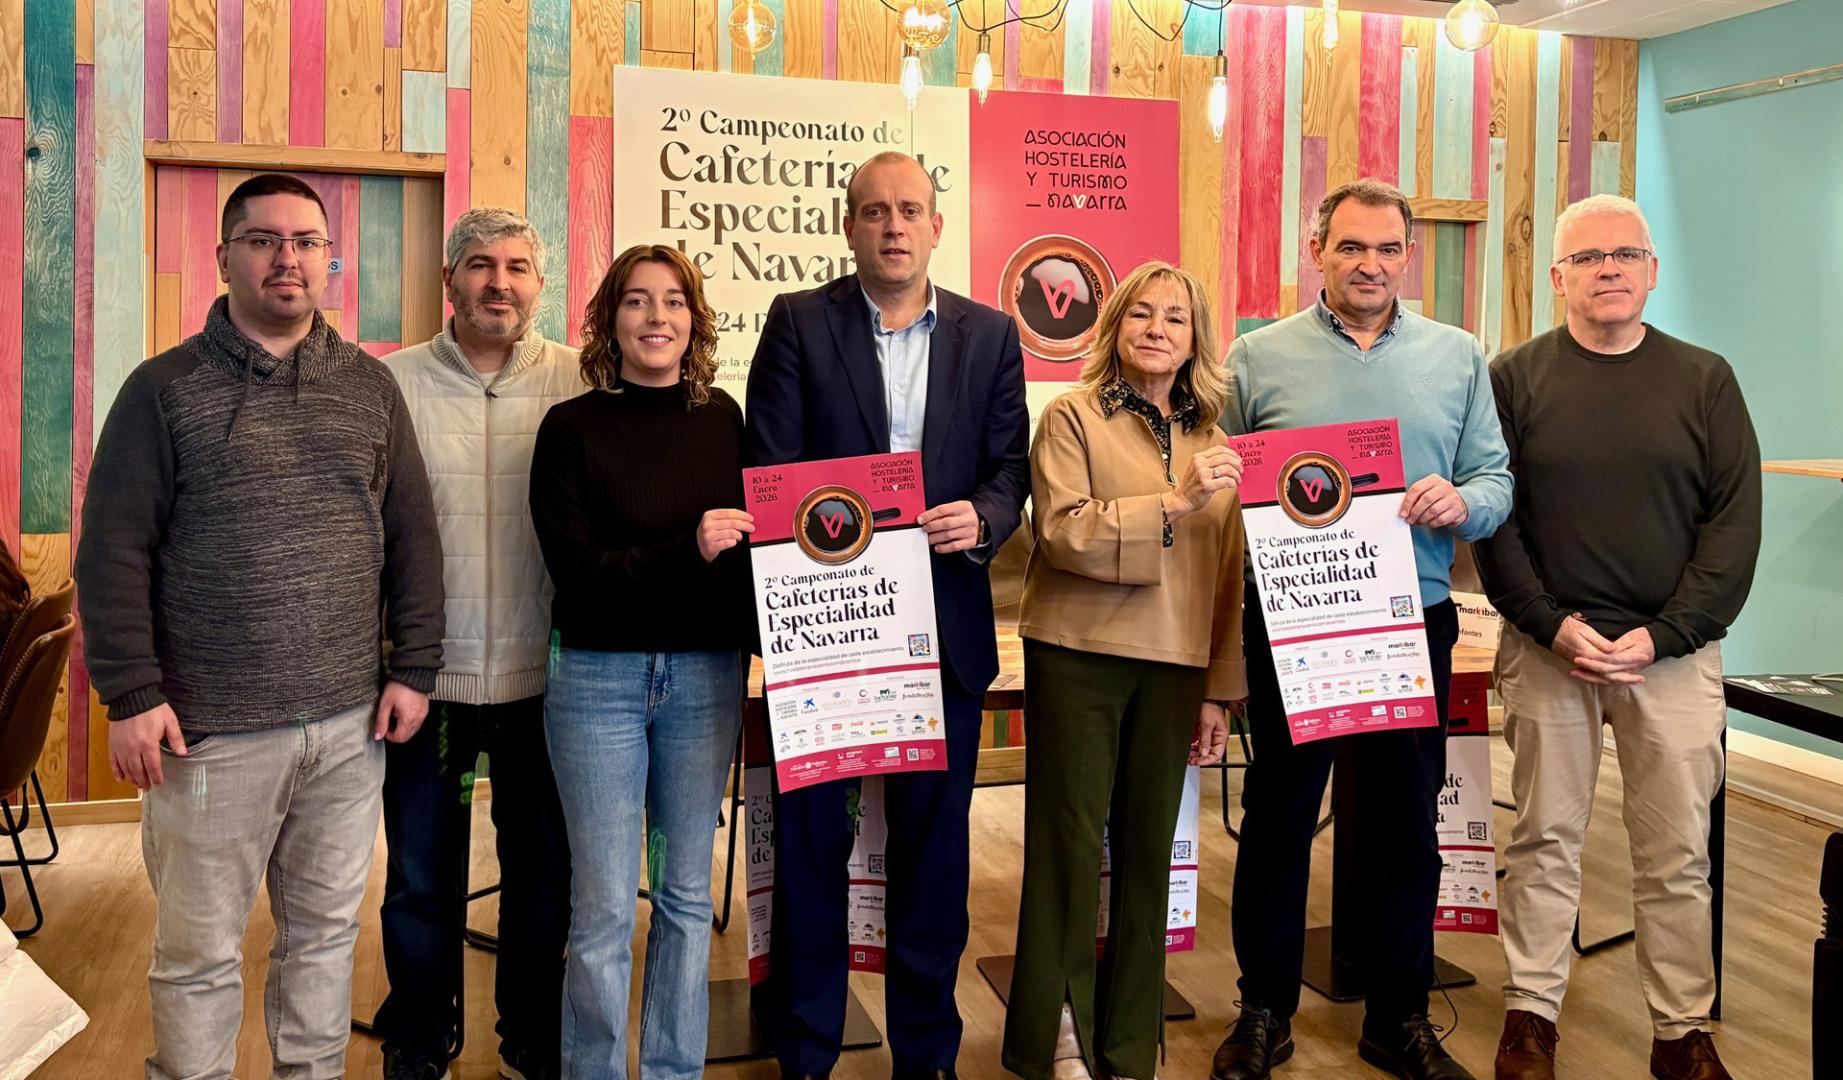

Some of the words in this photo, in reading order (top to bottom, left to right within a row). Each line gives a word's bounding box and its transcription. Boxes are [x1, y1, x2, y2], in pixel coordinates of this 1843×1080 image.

[700, 109, 865, 145] Campeonato
[872, 120, 904, 145] de
[1024, 129, 1126, 149] ASOCIACIÓN
[660, 140, 858, 190] Cafetería
[1024, 150, 1127, 170] HOSTELERÍA
[1026, 171, 1038, 187] Y
[1048, 171, 1128, 190] TURISMO
[660, 189, 851, 245] Especial
[731, 241, 857, 283] Navar
[717, 311, 746, 333] 24
[1347, 425, 1391, 437] ASOCIACIÓN
[870, 458, 914, 470] ASOCIACIÓN
[755, 494, 778, 504] 2026
[1269, 530, 1338, 549] Campeonato
[1340, 528, 1355, 540] de
[1258, 545, 1350, 570] Cafeterías
[1355, 541, 1380, 560] de
[781, 568, 857, 587] Campeonato
[860, 564, 875, 577] de
[1261, 560, 1378, 595] Especialidad
[765, 582, 869, 611] Cafeterías
[874, 577, 900, 597] de
[1266, 594, 1289, 614] de
[1289, 587, 1363, 611] Navarra
[767, 597, 897, 636] Especialidad
[770, 634, 795, 655] de
[801, 626, 880, 650] Navarra
